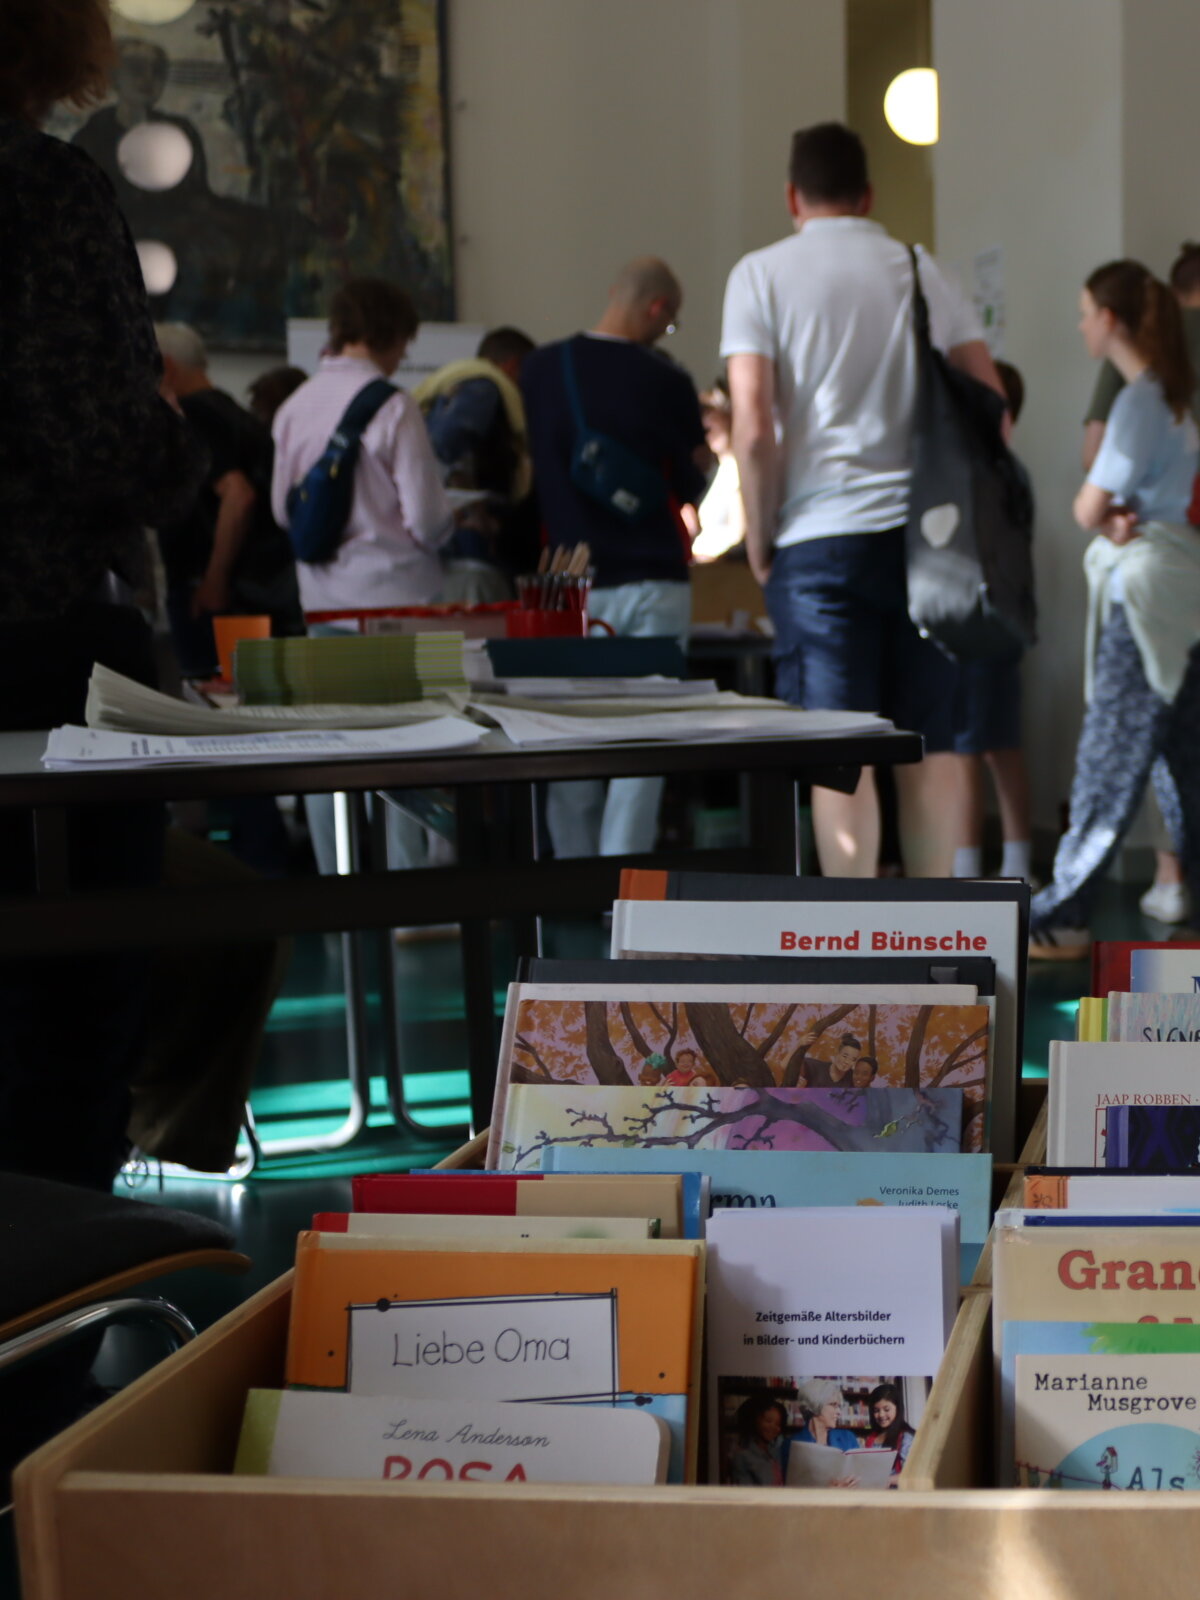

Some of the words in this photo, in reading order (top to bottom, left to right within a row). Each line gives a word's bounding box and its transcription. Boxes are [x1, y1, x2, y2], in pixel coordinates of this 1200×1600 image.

[780, 930, 860, 951] Bernd
[871, 930, 987, 951] Bünsche
[1096, 1094, 1129, 1107] JAAP
[1133, 1094, 1191, 1105] ROBBEN
[879, 1186, 923, 1196] Veronika
[926, 1187, 959, 1196] Demes
[755, 1311, 822, 1325] Zeitgemäße
[824, 1311, 891, 1322] Altersbilder
[392, 1330, 485, 1367] Liebe
[494, 1328, 570, 1363] Oma
[743, 1334, 754, 1345] in
[756, 1334, 795, 1345] Bilder-
[798, 1334, 819, 1345] und
[822, 1334, 905, 1345] Kinderbüchern
[1034, 1372, 1148, 1392] Marianne
[1087, 1393, 1197, 1415] Musgrove
[382, 1419, 439, 1443] Lena
[446, 1424, 551, 1448] Anderson
[1125, 1466, 1185, 1491] Als
